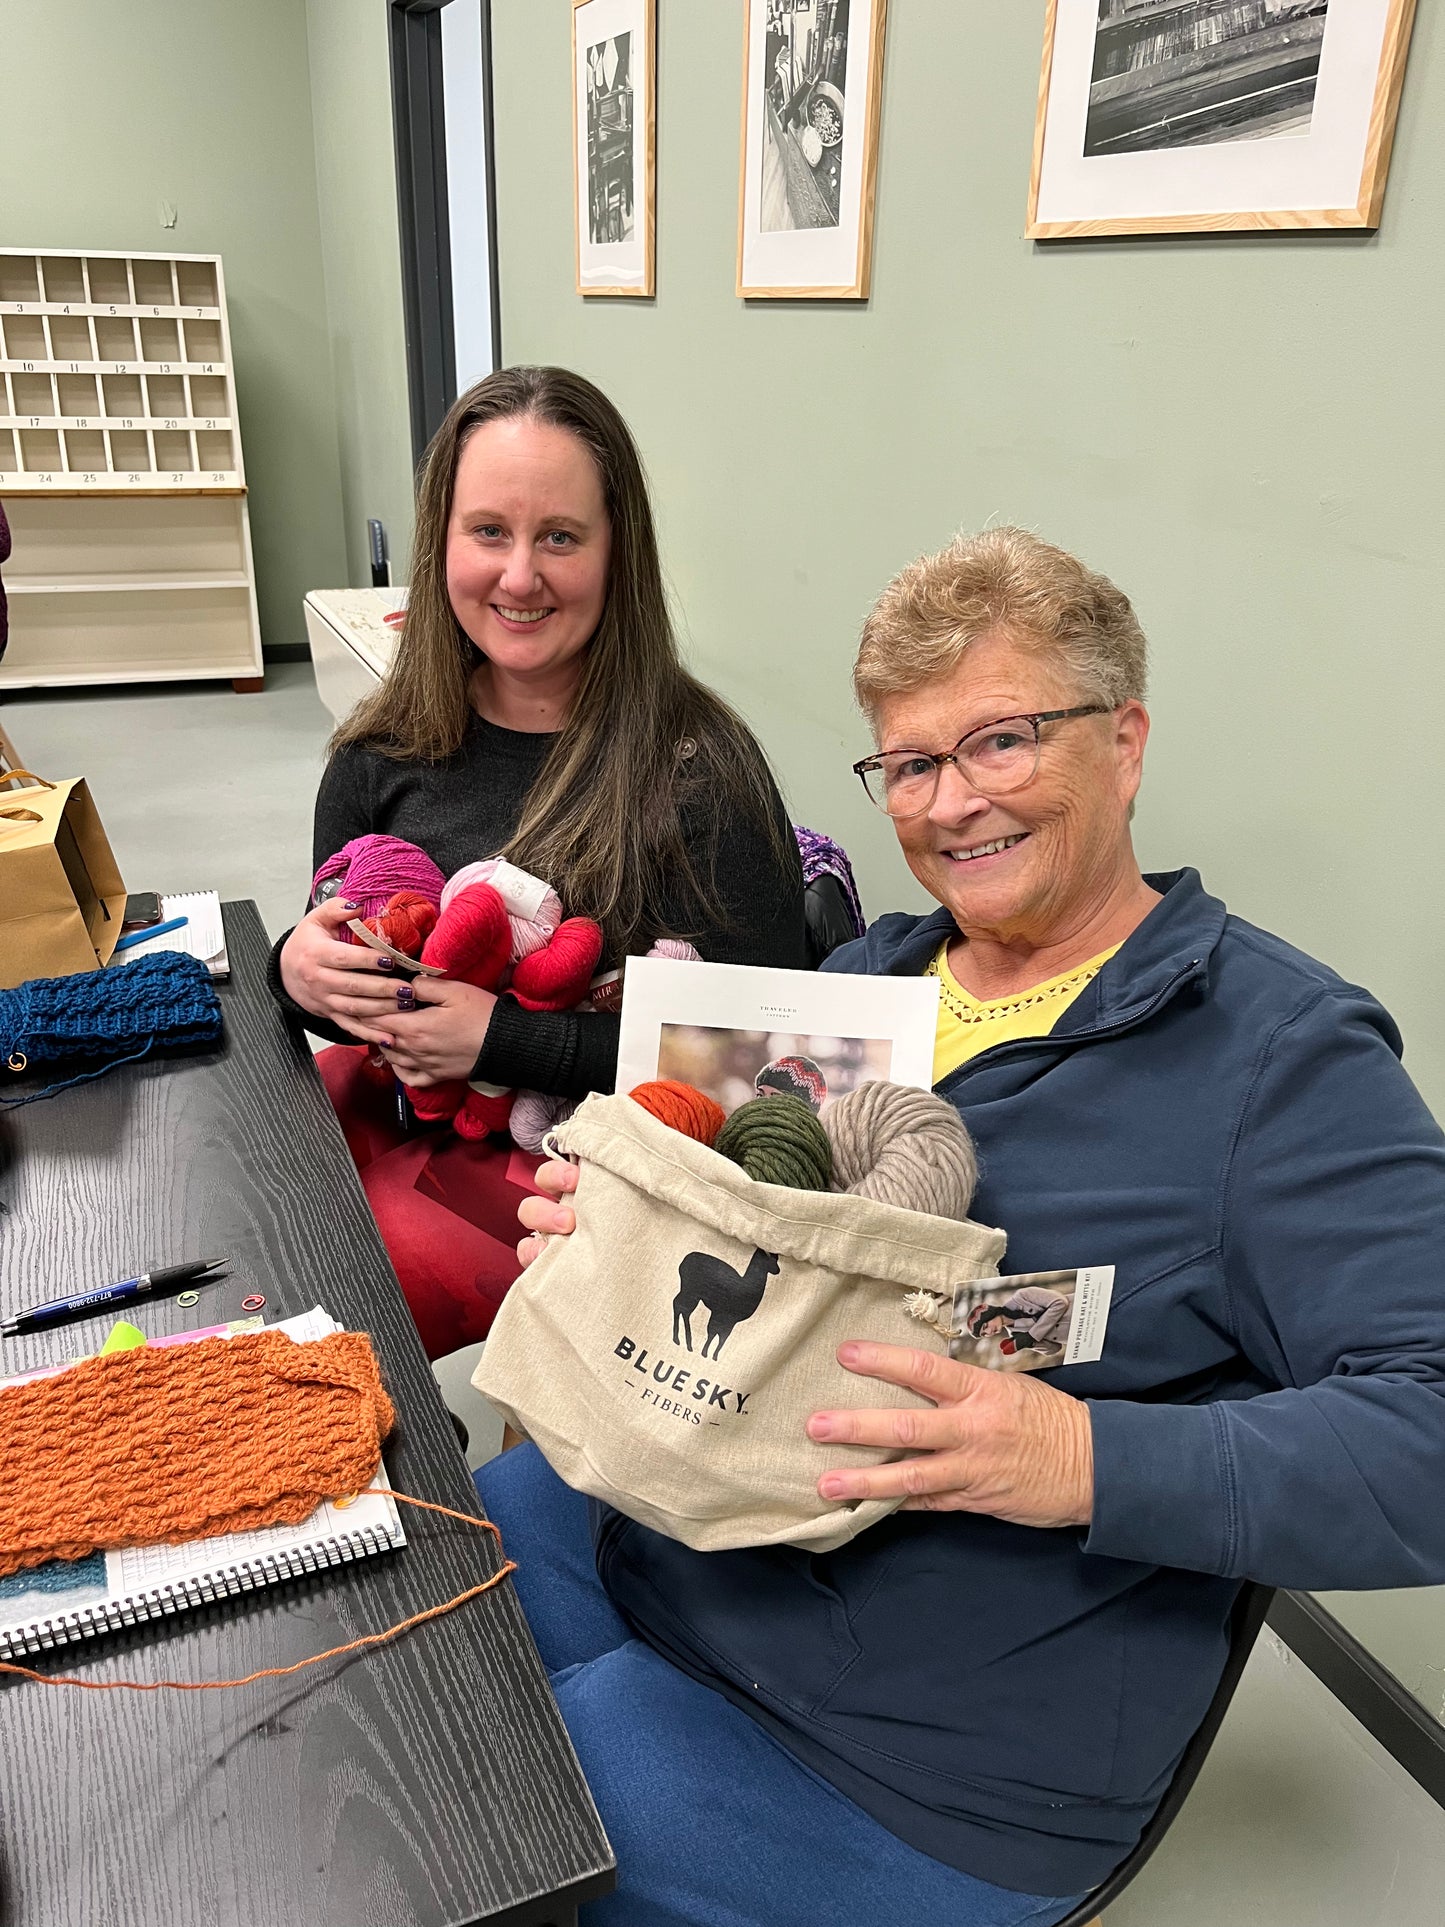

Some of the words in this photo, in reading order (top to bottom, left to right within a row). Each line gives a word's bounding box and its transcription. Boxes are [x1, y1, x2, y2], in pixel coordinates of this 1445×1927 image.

[17, 304, 24, 312] 3
[63, 305, 70, 314] 4
[109, 306, 117, 315] 5
[153, 307, 160, 316] 6
[197, 309, 203, 317] 7
[23, 363, 34, 372] 10
[70, 363, 79, 372] 11
[115, 365, 126, 374] 12
[160, 365, 171, 373] 13
[202, 365, 213, 373] 14
[30, 418, 40, 427] 17
[76, 419, 87, 428] 18
[122, 420, 133, 428] 19
[164, 420, 177, 428] 20
[206, 420, 216, 428] 21
[39, 474, 52, 482] 24
[84, 474, 96, 482] 25
[129, 474, 141, 482] 26
[172, 474, 184, 482] 27
[212, 474, 225, 482] 28
[613, 1335, 691, 1392] BLUE
[640, 1388, 702, 1425] FIBERS
